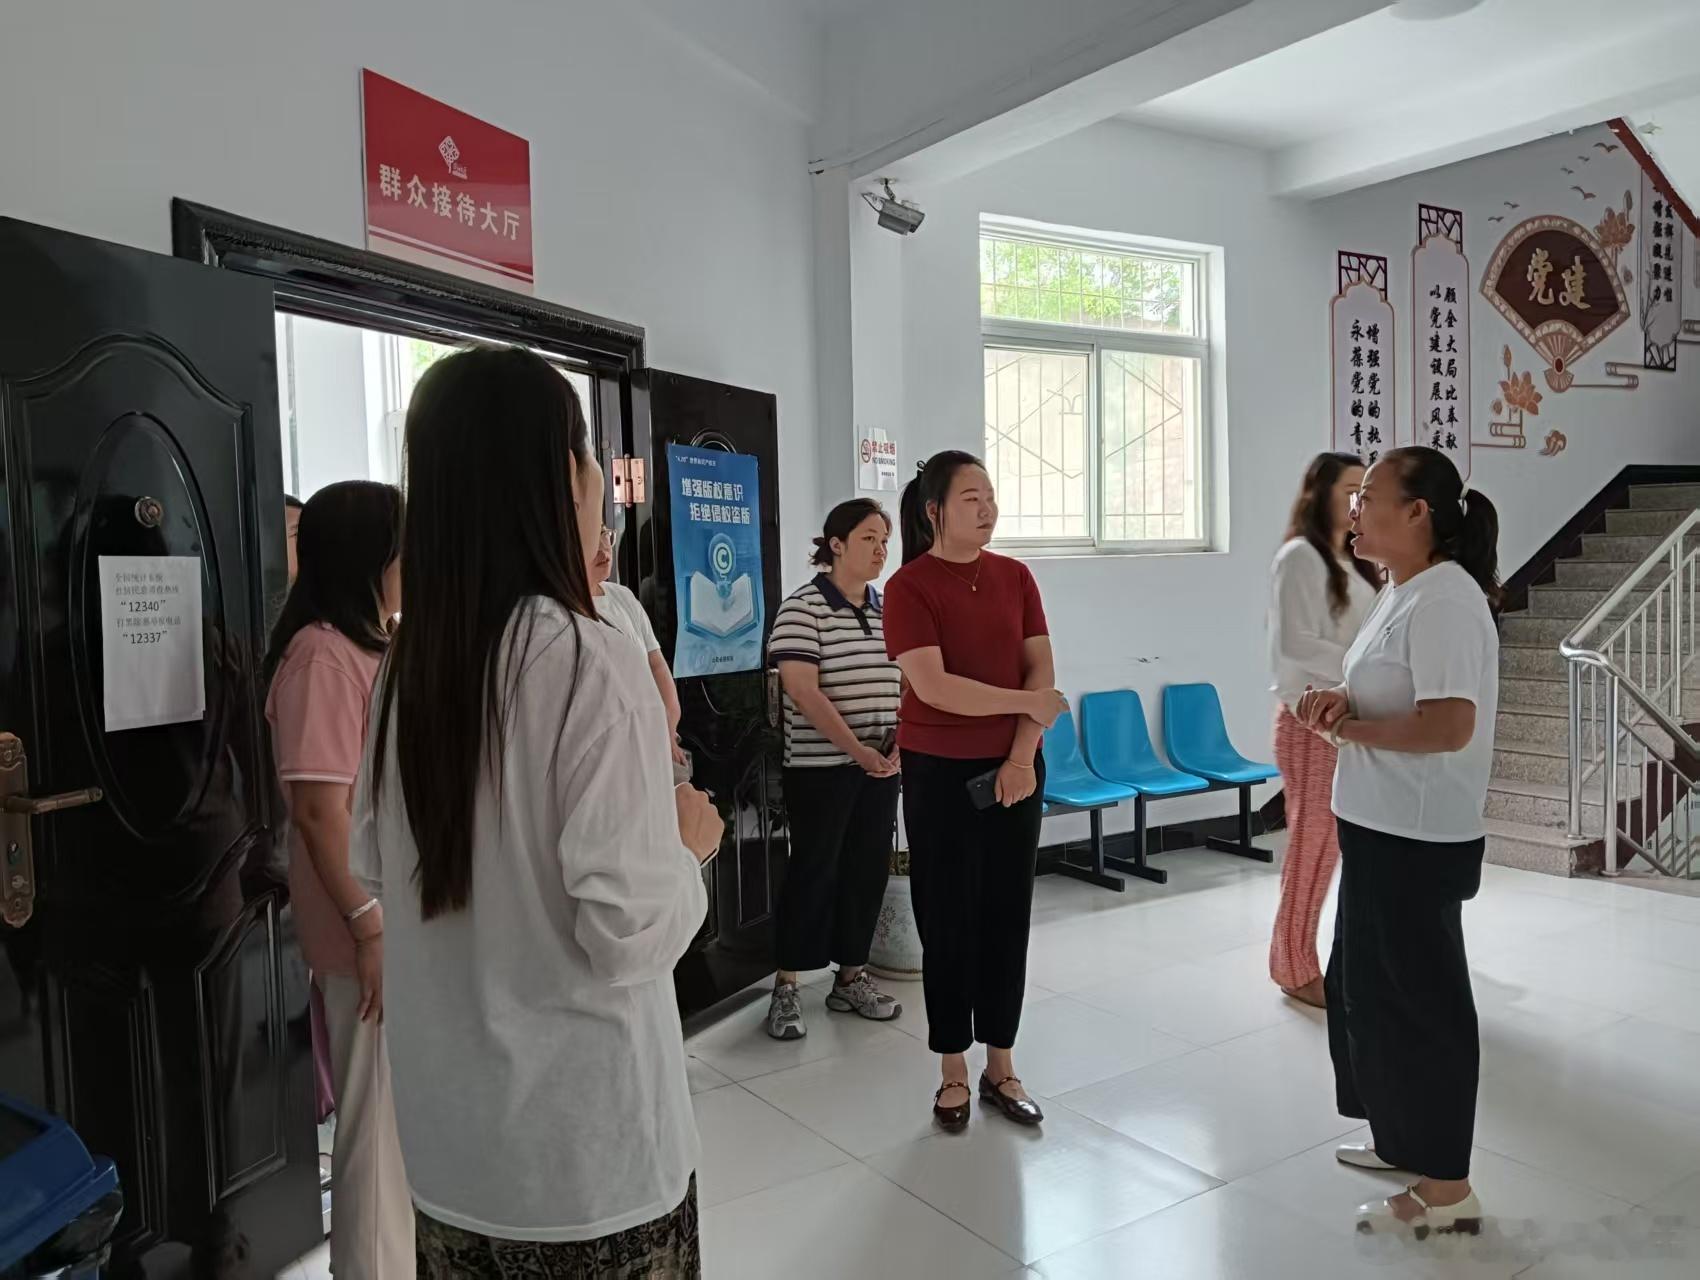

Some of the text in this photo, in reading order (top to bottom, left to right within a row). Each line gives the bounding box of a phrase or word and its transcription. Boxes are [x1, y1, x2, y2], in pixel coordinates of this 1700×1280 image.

[379, 163, 520, 241] 群众接待大厅
[1527, 248, 1591, 309] 党建
[1350, 318, 1365, 454] 永葆党的青
[872, 441, 896, 455] 禁止吸烟
[681, 477, 745, 502] 增强版权意识
[689, 501, 751, 525] 拒绝侵权盗版
